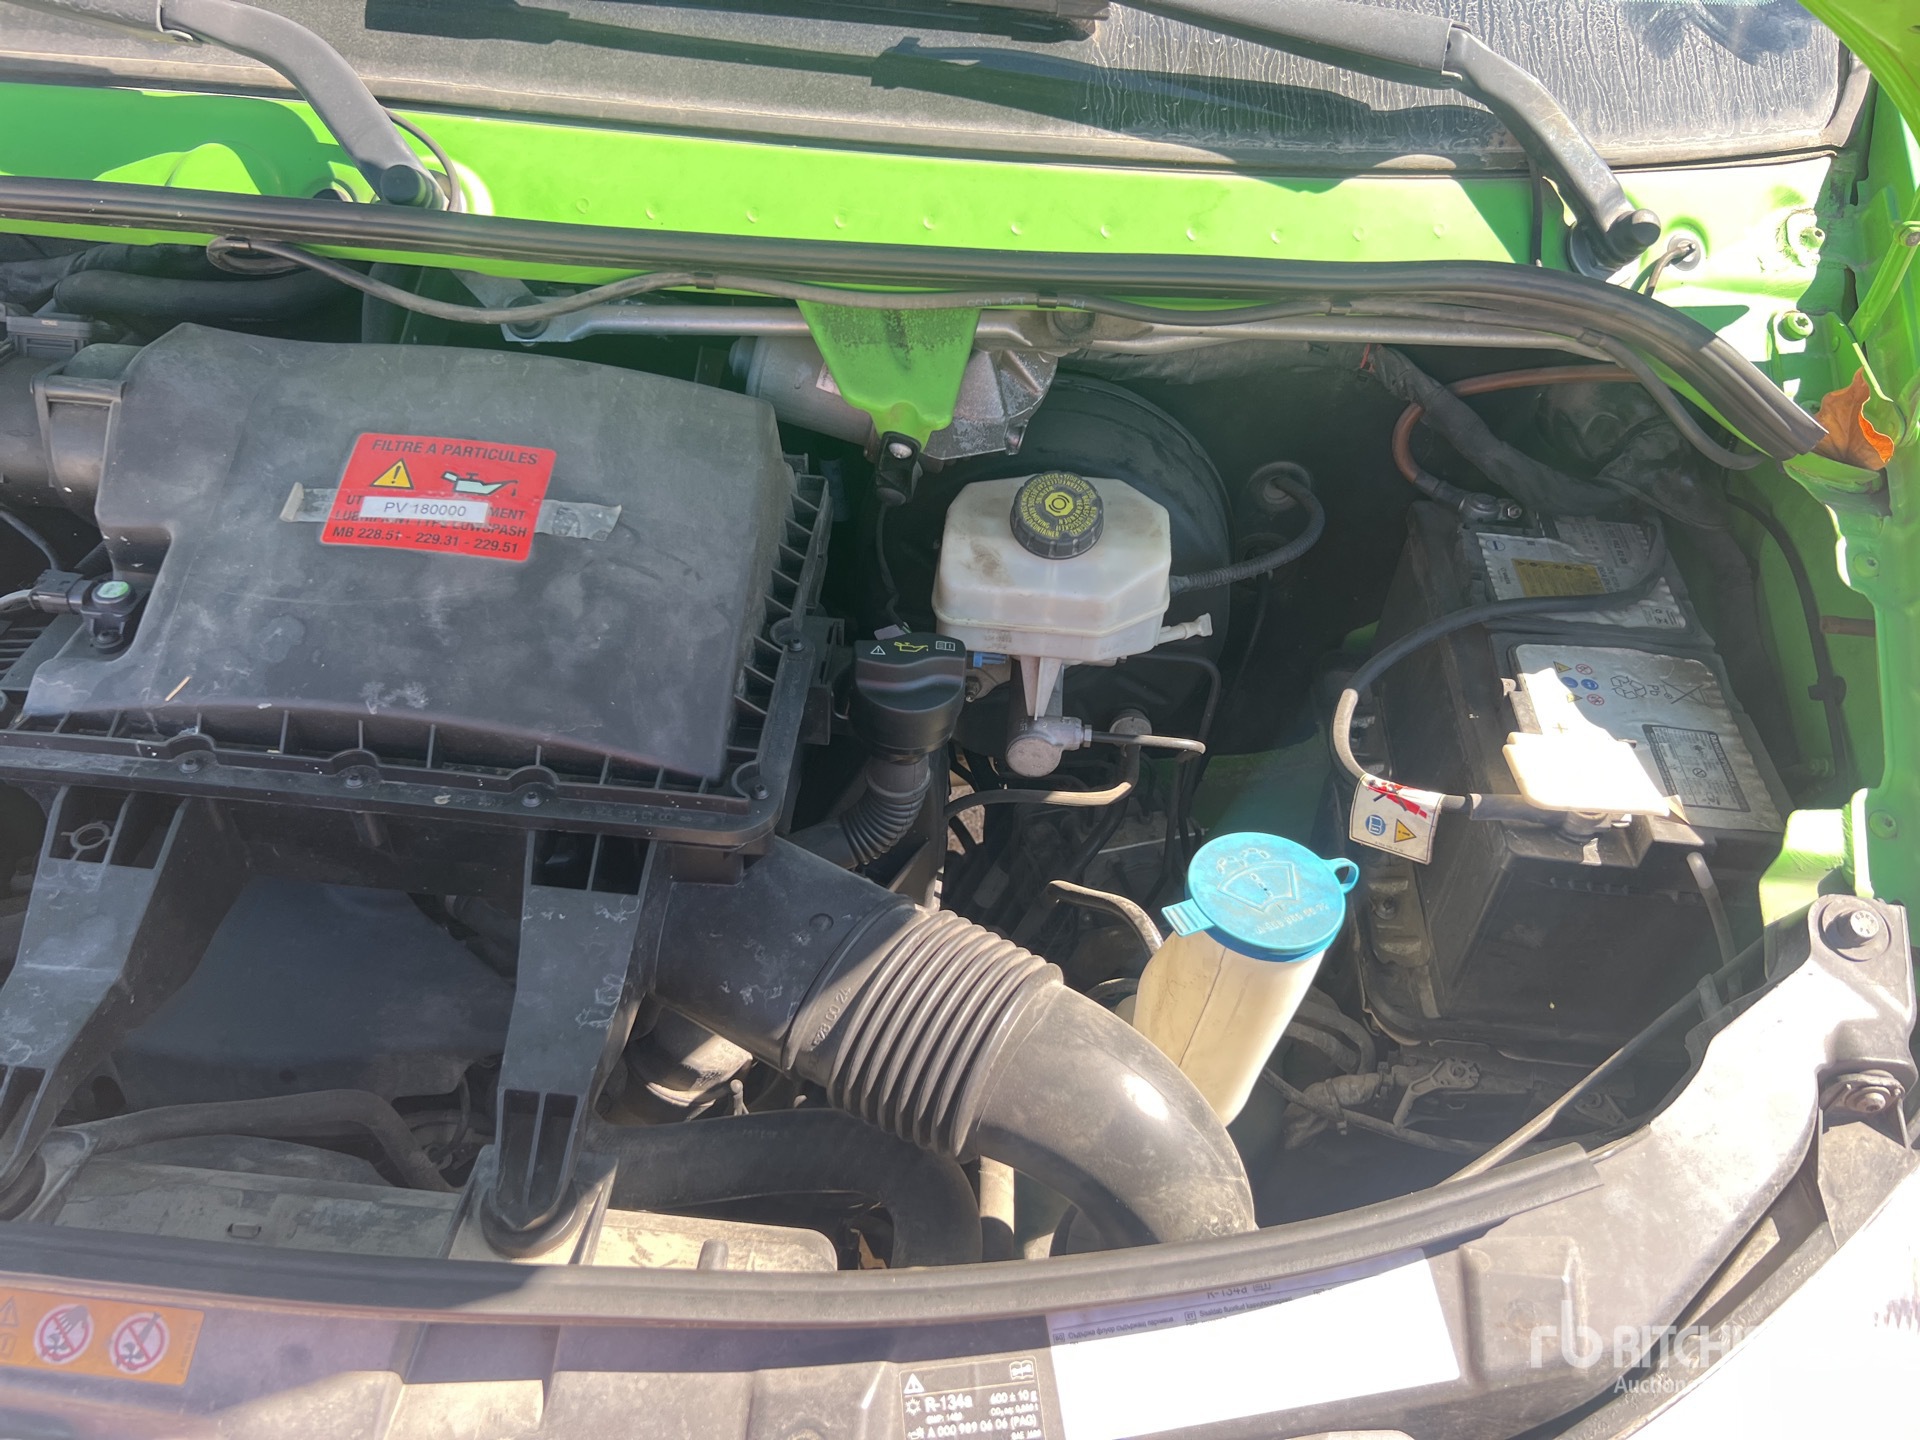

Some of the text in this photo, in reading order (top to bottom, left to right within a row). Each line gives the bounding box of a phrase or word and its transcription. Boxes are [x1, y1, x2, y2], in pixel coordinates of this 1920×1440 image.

[372, 439, 538, 465] FILTRE A PARTICULES
[384, 502, 467, 516] PV 180000
[333, 526, 354, 537] MB
[358, 528, 401, 541] 228.51
[416, 532, 458, 546] 229.31
[474, 539, 518, 553] 229.51
[925, 1393, 973, 1412] R-134a
